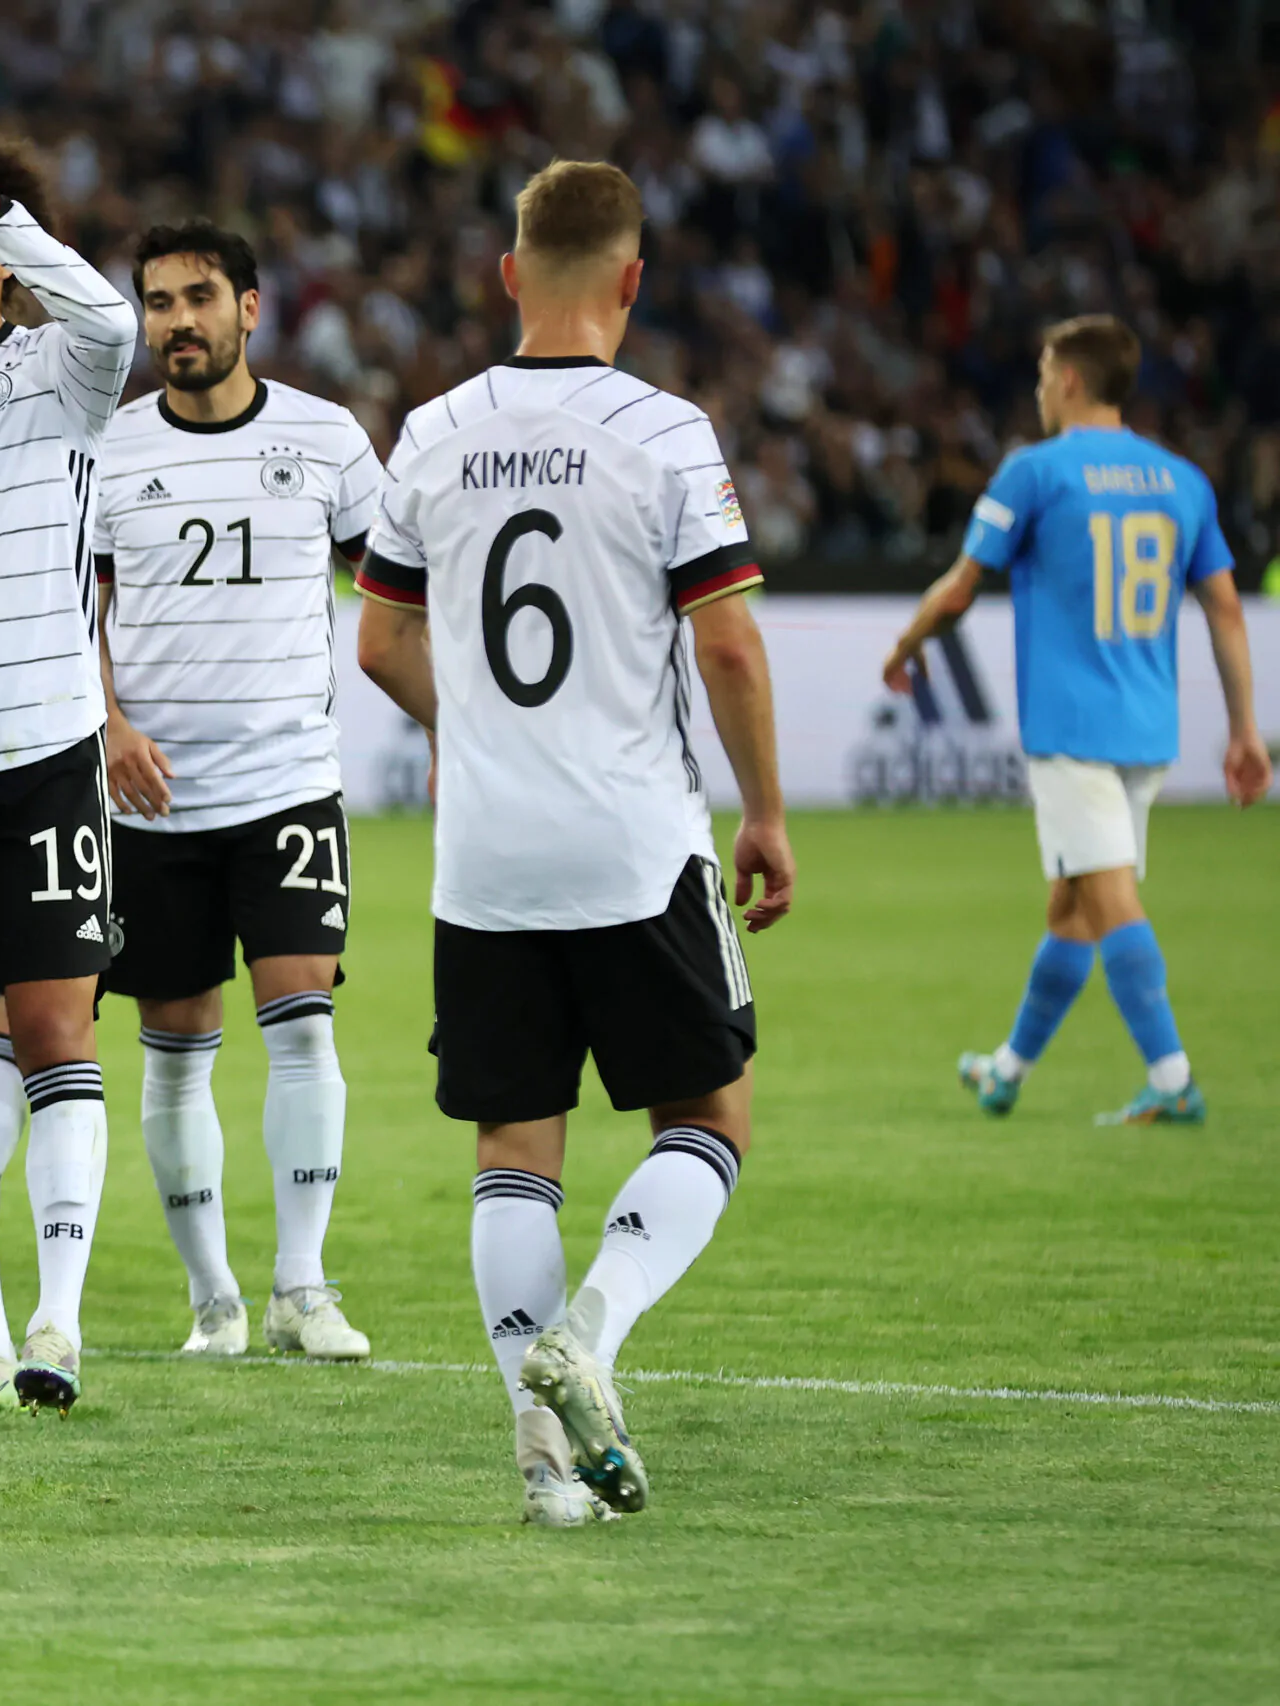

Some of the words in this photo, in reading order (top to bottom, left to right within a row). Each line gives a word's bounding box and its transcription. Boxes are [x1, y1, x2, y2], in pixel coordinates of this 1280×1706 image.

[462, 447, 587, 490] KIMMICH
[1082, 463, 1177, 496] BARELLA
[178, 517, 263, 586] 21
[1089, 511, 1177, 640] 18
[482, 508, 574, 708] 6
[29, 825, 103, 902] 19
[276, 824, 348, 896] 21
[76, 929, 104, 944] adidas
[293, 1167, 338, 1184] DFB
[168, 1188, 213, 1208] DFB
[44, 1222, 84, 1240] DFB
[604, 1225, 652, 1241] adidas
[492, 1325, 544, 1340] adidas
